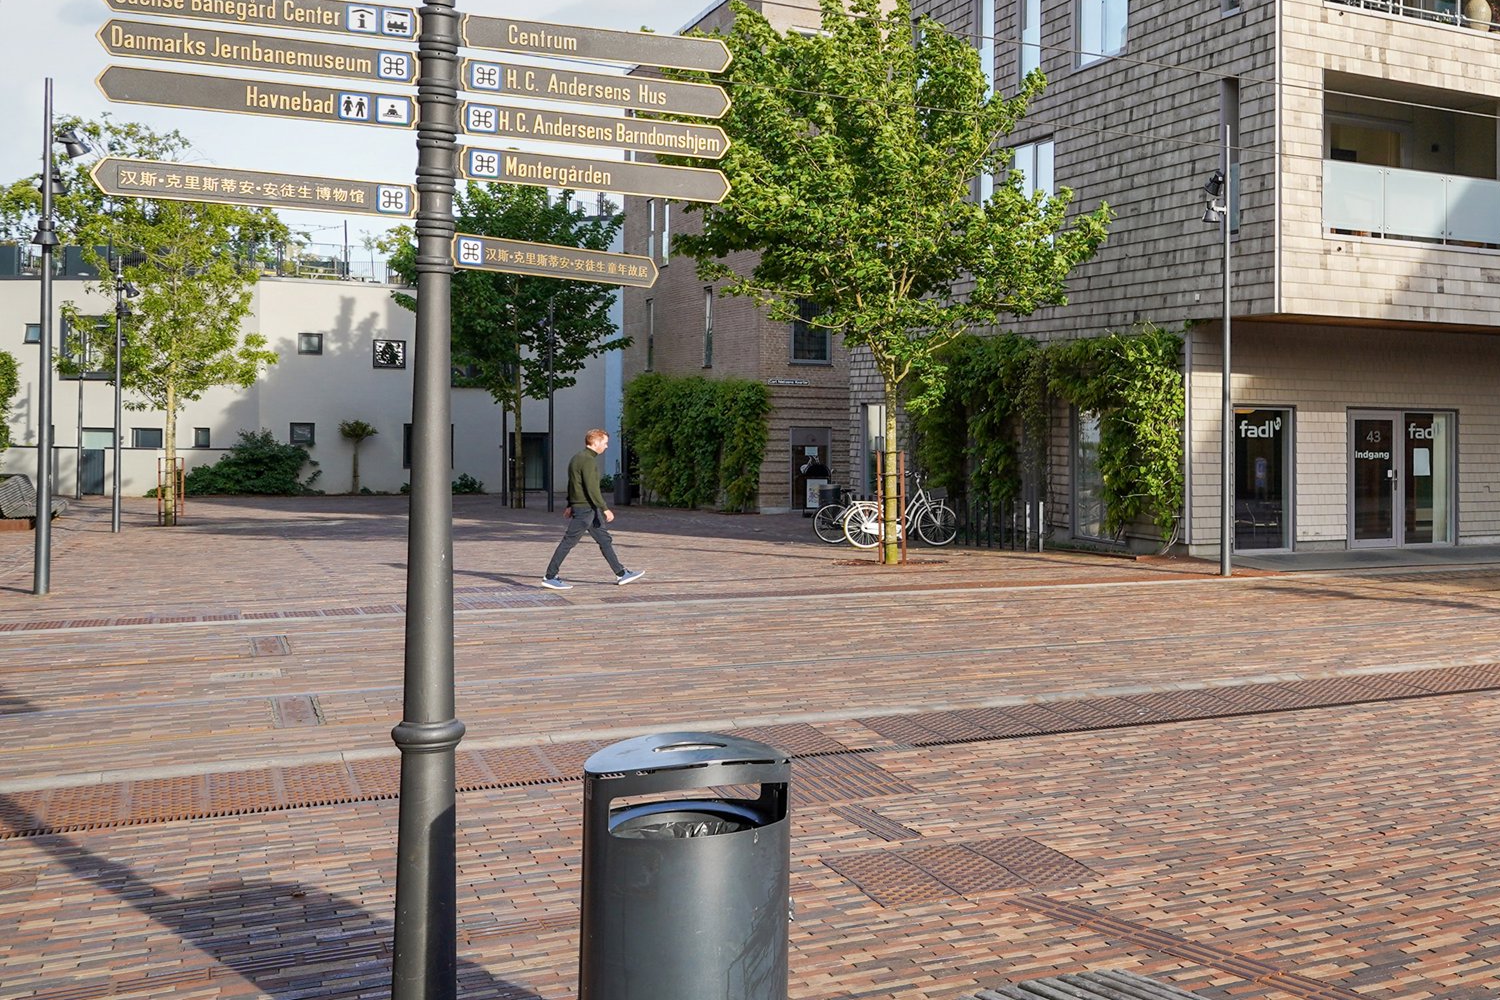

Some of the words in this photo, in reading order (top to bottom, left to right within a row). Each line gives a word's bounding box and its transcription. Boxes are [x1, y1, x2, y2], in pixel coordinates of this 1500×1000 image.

[283, 0, 341, 26] Center
[111, 25, 206, 56] Danmarks
[211, 37, 372, 74] Jernbanemuseum
[508, 24, 577, 51] Centrum
[246, 86, 334, 115] Havnebad
[548, 73, 631, 102] Andersens
[638, 84, 667, 105] Hus
[533, 115, 613, 142] Andersens
[616, 122, 721, 154] Barndomshjem
[505, 155, 612, 186] Møntergården
[1239, 420, 1274, 438] fadl
[1366, 430, 1381, 442] 43
[1355, 450, 1390, 460] Indgang
